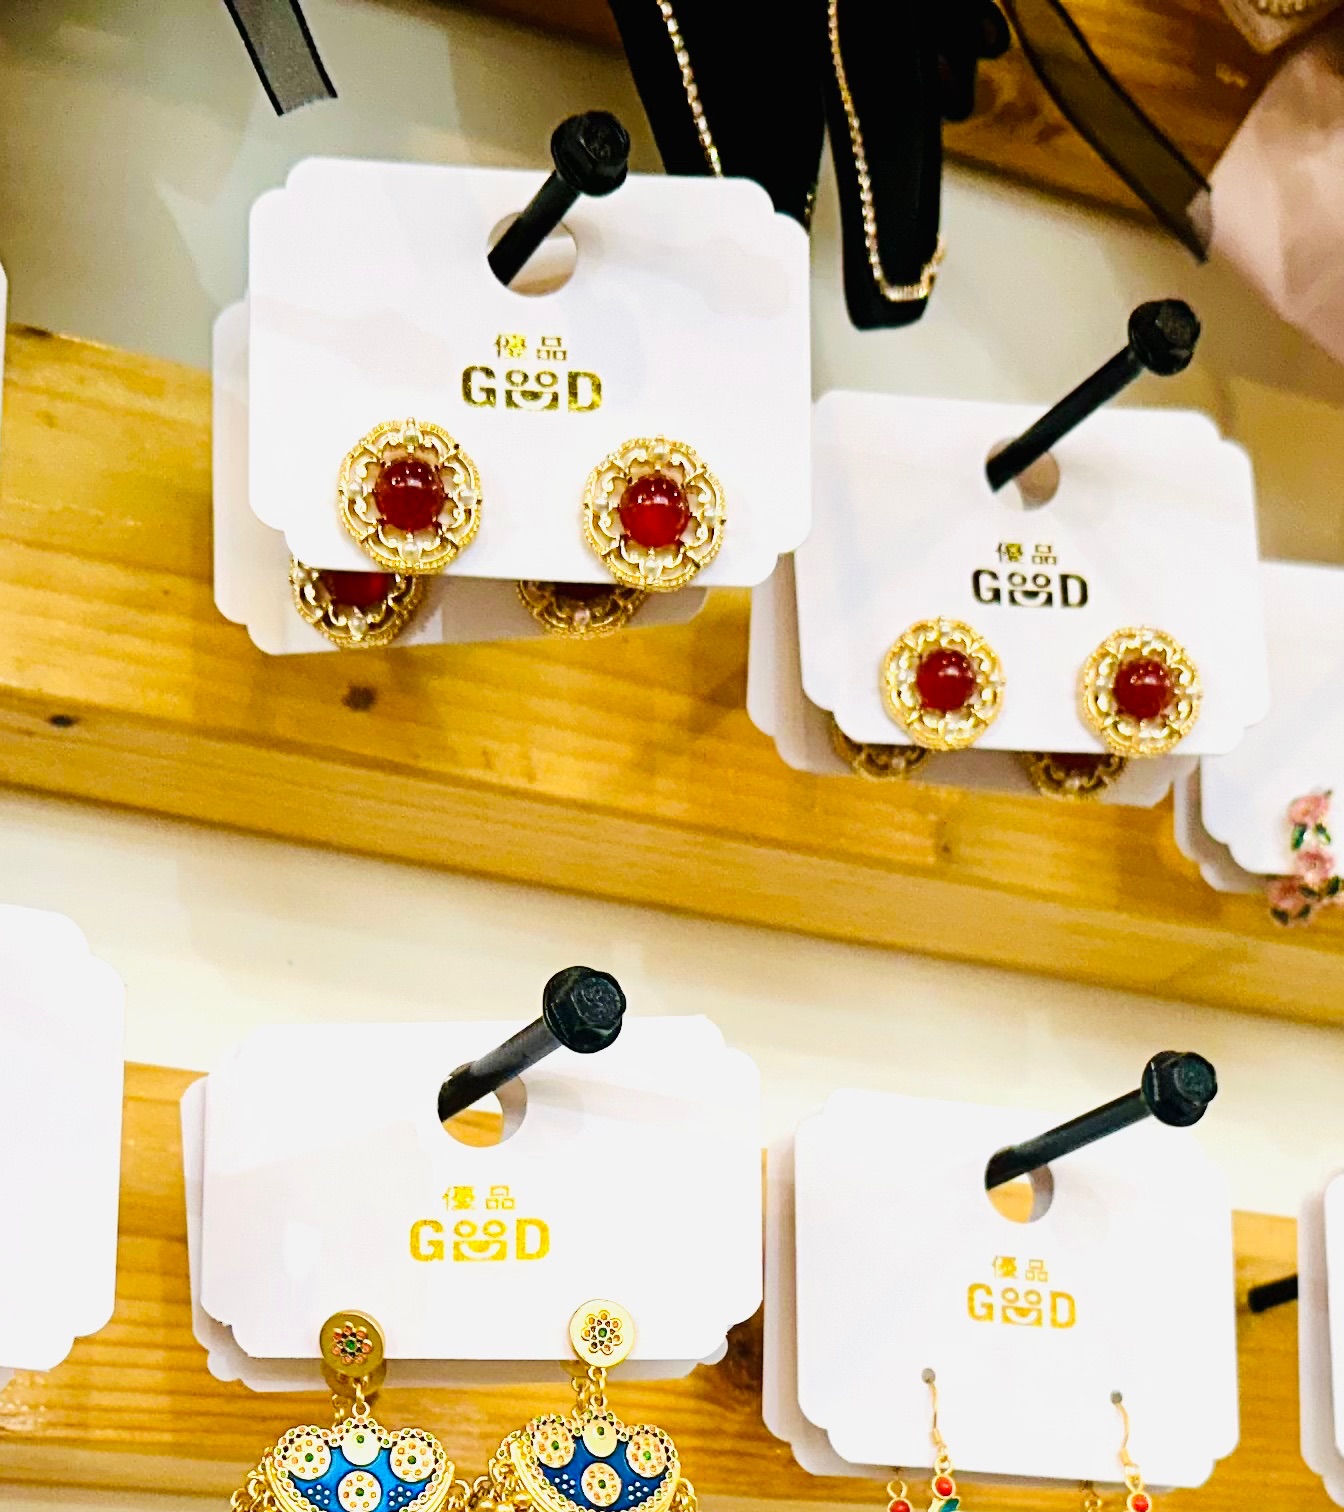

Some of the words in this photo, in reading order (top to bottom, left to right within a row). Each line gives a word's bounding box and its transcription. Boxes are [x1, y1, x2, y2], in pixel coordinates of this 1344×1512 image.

[495, 333, 567, 362] 優品
[462, 365, 602, 413] GOOD
[995, 542, 1057, 566] 優品
[971, 568, 1088, 609] GOOD
[441, 1186, 515, 1211] 優品
[409, 1218, 550, 1262] GOOD
[992, 1255, 1048, 1283] 優品
[967, 1283, 1076, 1328] GOOD
